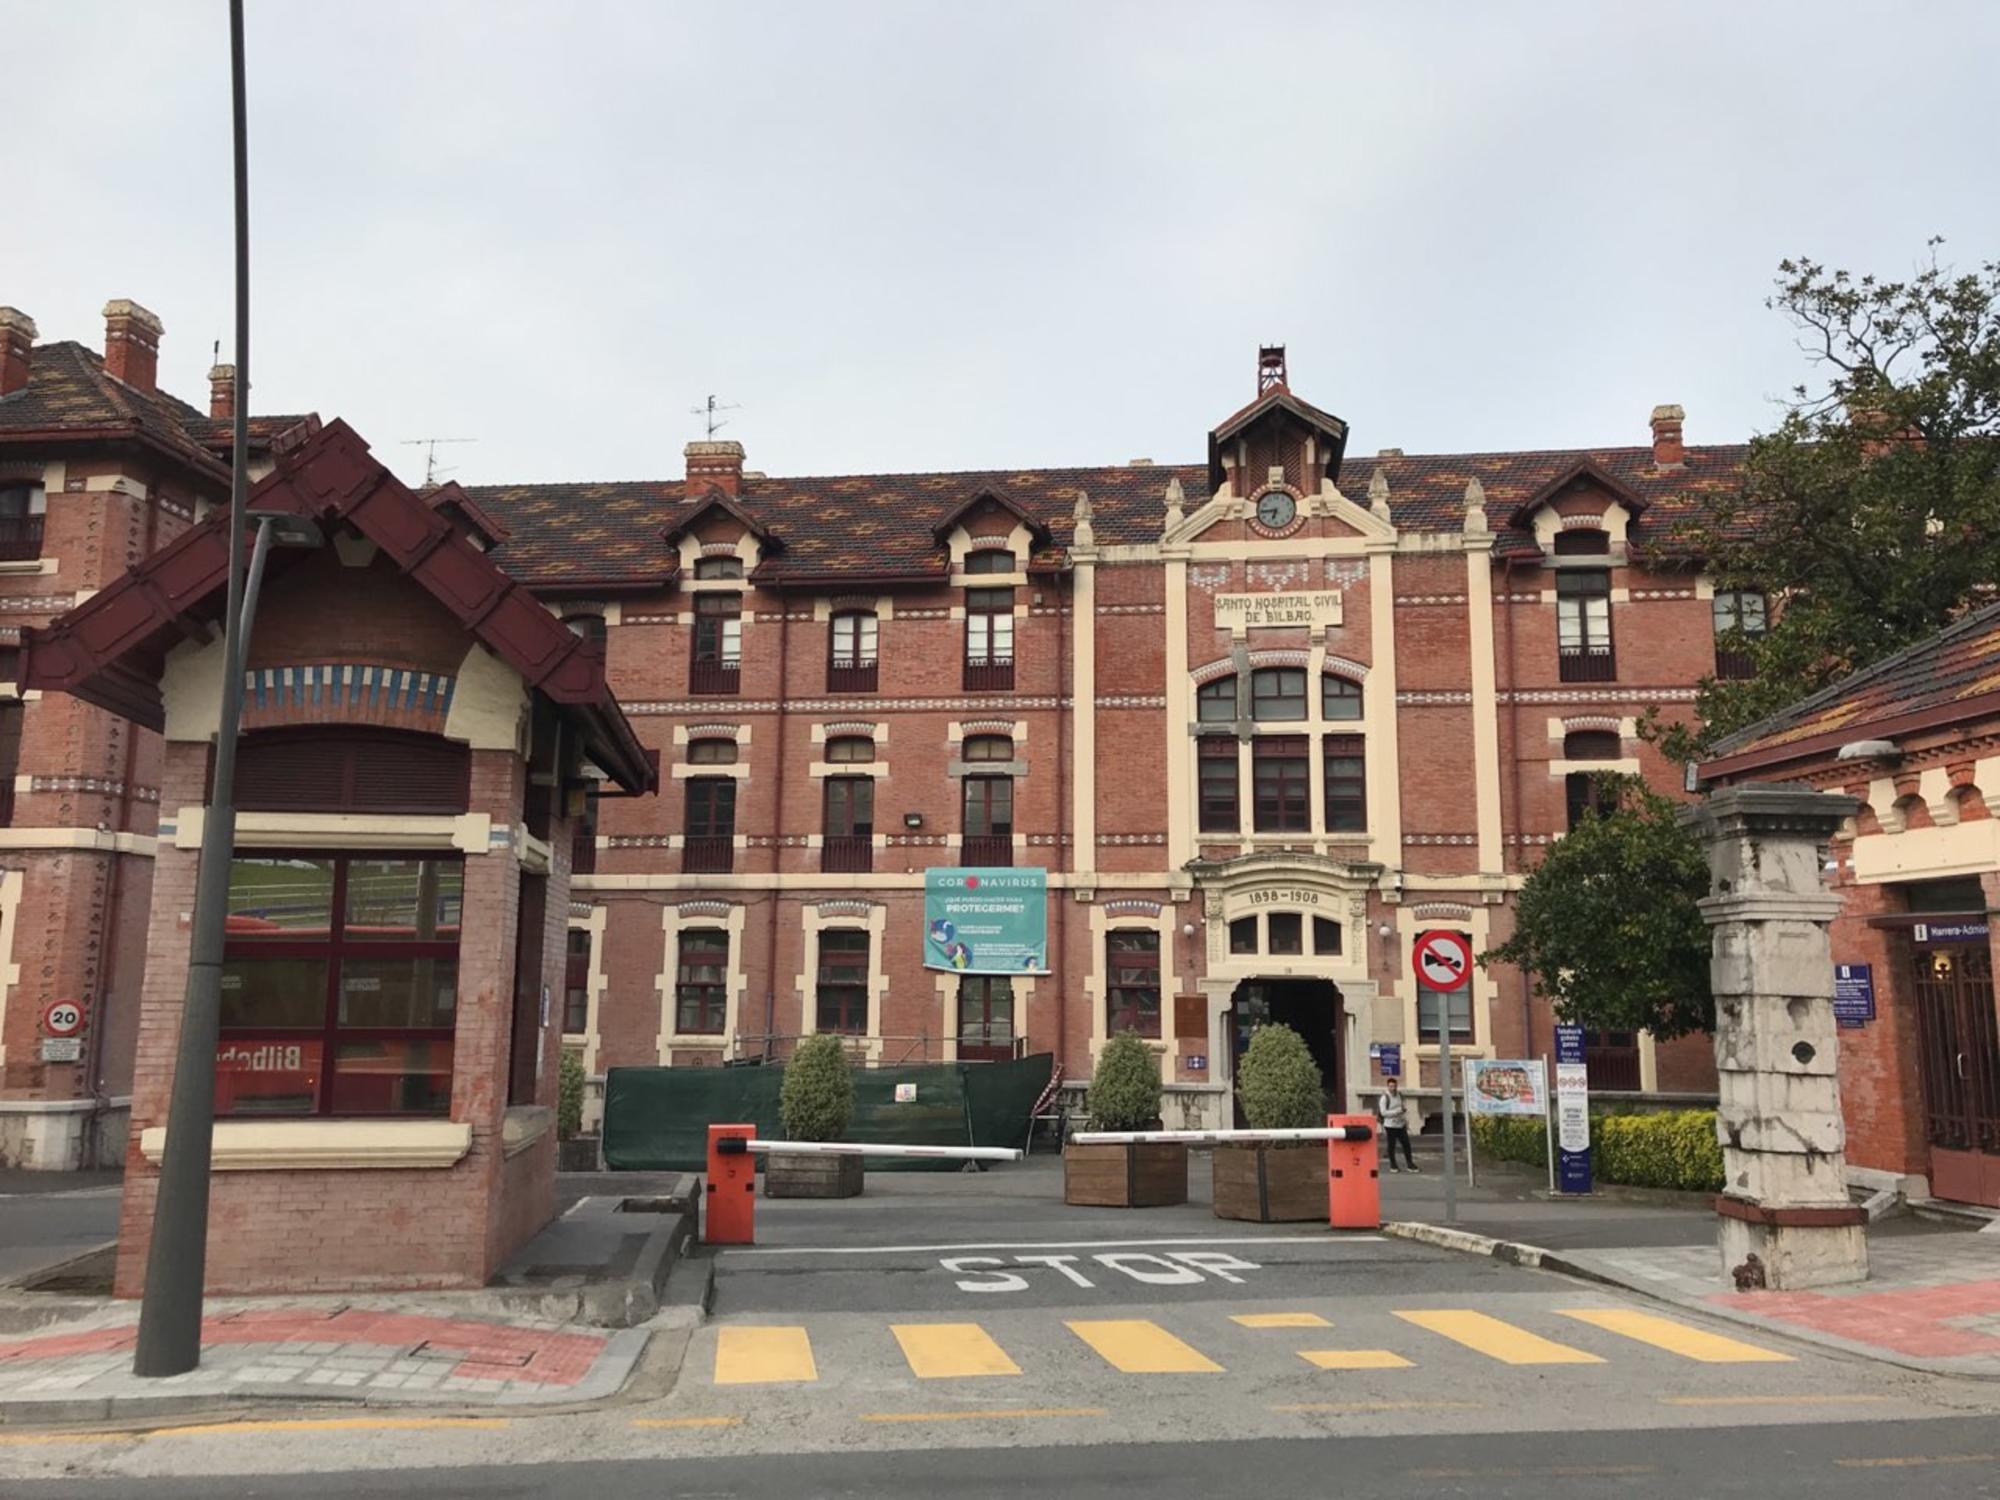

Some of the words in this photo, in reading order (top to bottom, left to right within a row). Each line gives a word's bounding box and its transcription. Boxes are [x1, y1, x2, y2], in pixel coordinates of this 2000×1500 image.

[1215, 597, 1252, 611] SANTO
[1255, 596, 1311, 609] HOSPITAL
[1314, 595, 1342, 607] CIVIL
[1245, 611, 1261, 622] DE
[53, 1011, 76, 1024] 20
[939, 1252, 1262, 1292] STOP
